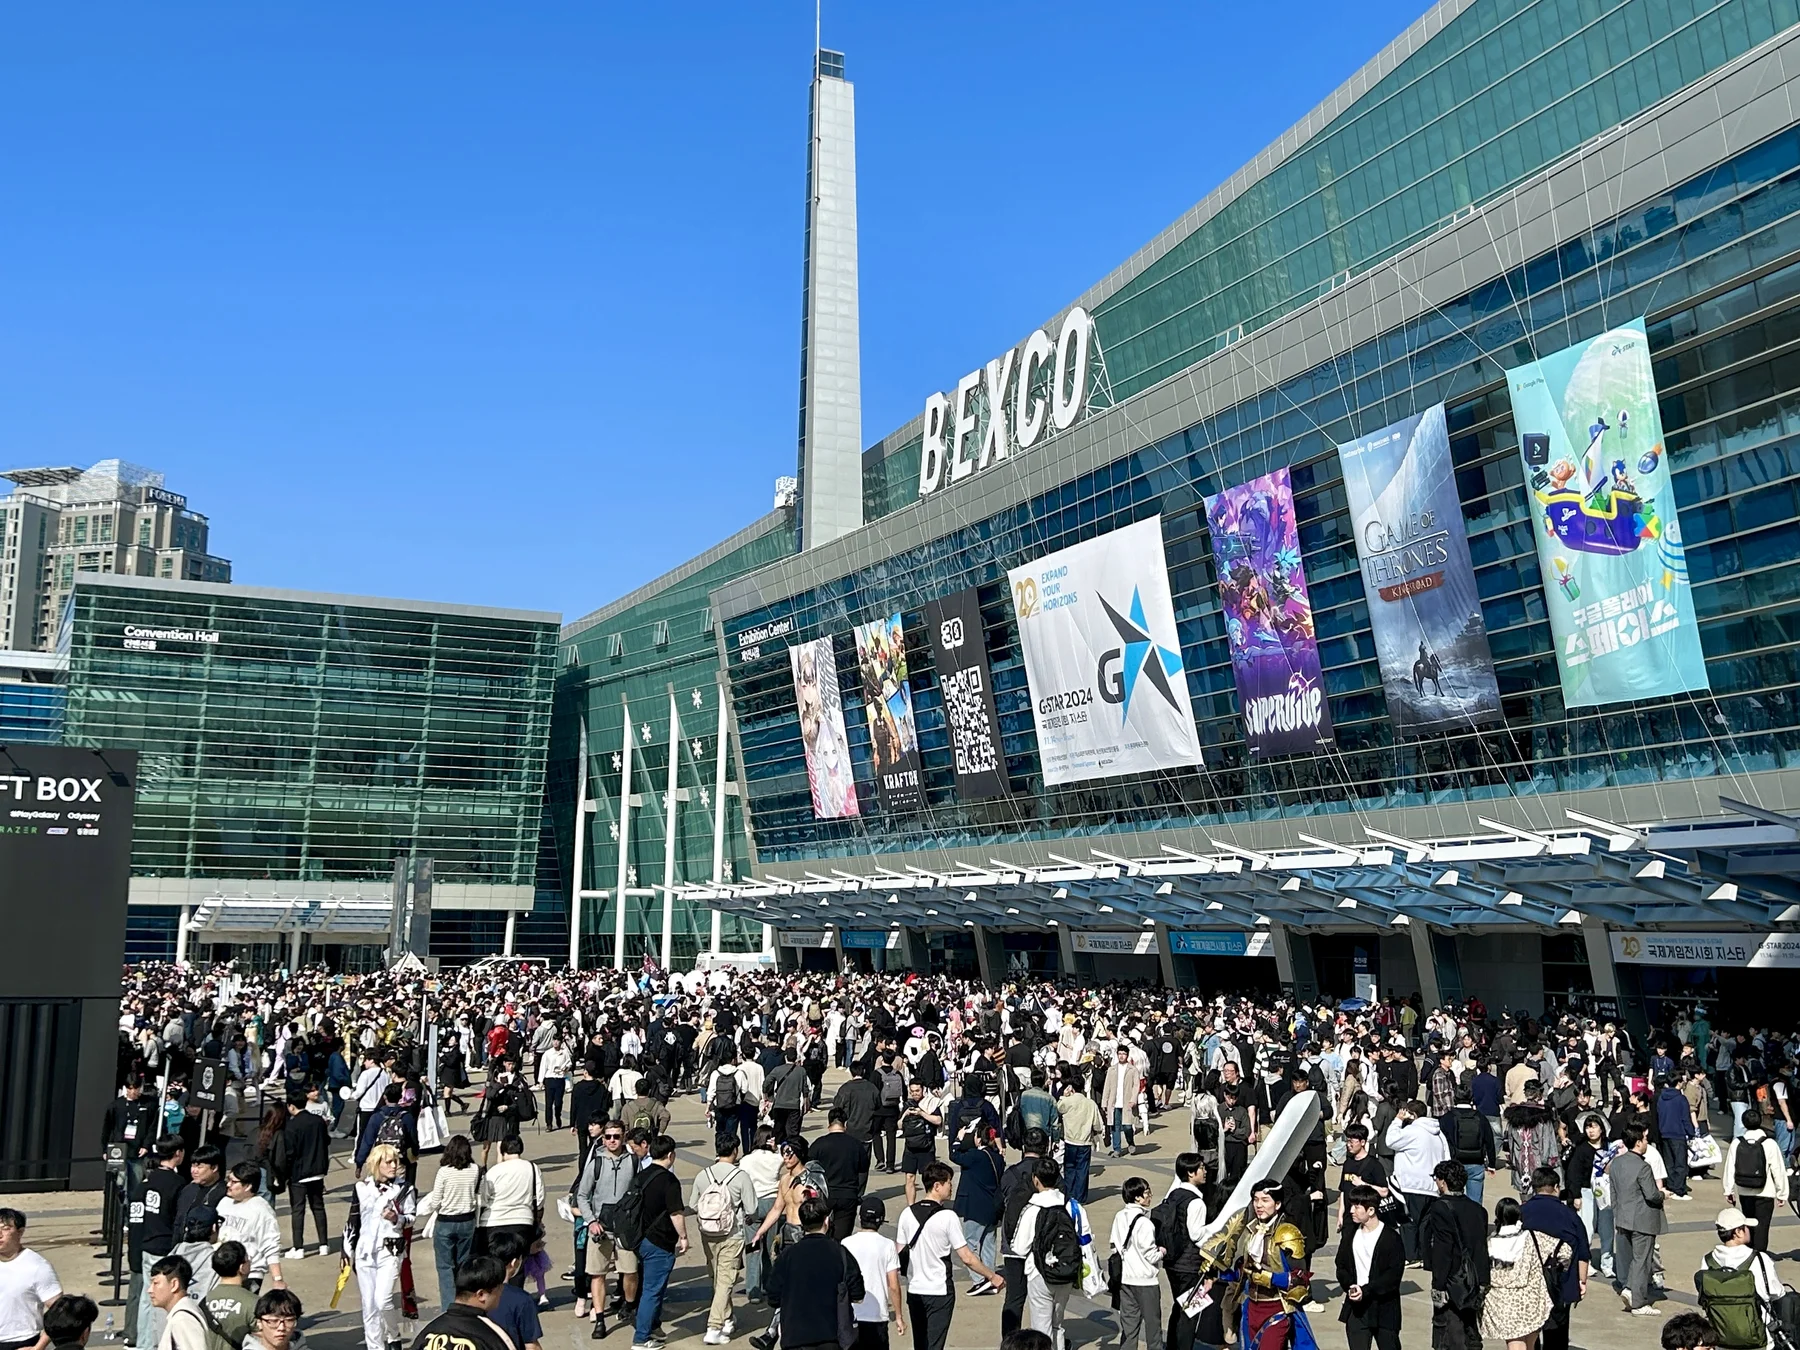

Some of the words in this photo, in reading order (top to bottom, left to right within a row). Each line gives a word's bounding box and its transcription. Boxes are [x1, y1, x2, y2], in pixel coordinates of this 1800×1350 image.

[918, 307, 1089, 498] BEXCO
[1364, 511, 1419, 554] GAME
[1420, 509, 1436, 529] OF
[1361, 537, 1449, 588] THRONES
[1041, 565, 1068, 585] EXPAND
[1041, 582, 1061, 598] YOUR
[1043, 591, 1078, 612] HORIZONS
[1573, 579, 1654, 628] 구글플레이
[123, 625, 194, 641] Convention
[194, 630, 219, 643] Hall
[738, 627, 769, 647] Exhibition
[768, 620, 790, 637] Center
[1565, 599, 1679, 668] 스페이스
[1065, 687, 1094, 709] 2024
[37, 776, 103, 803] BOX
[67, 811, 100, 821] Odyssey
[1648, 945, 1714, 960] 국제게임전시회
[1716, 946, 1746, 961] 지스타
[206, 1298, 242, 1315] OREA
